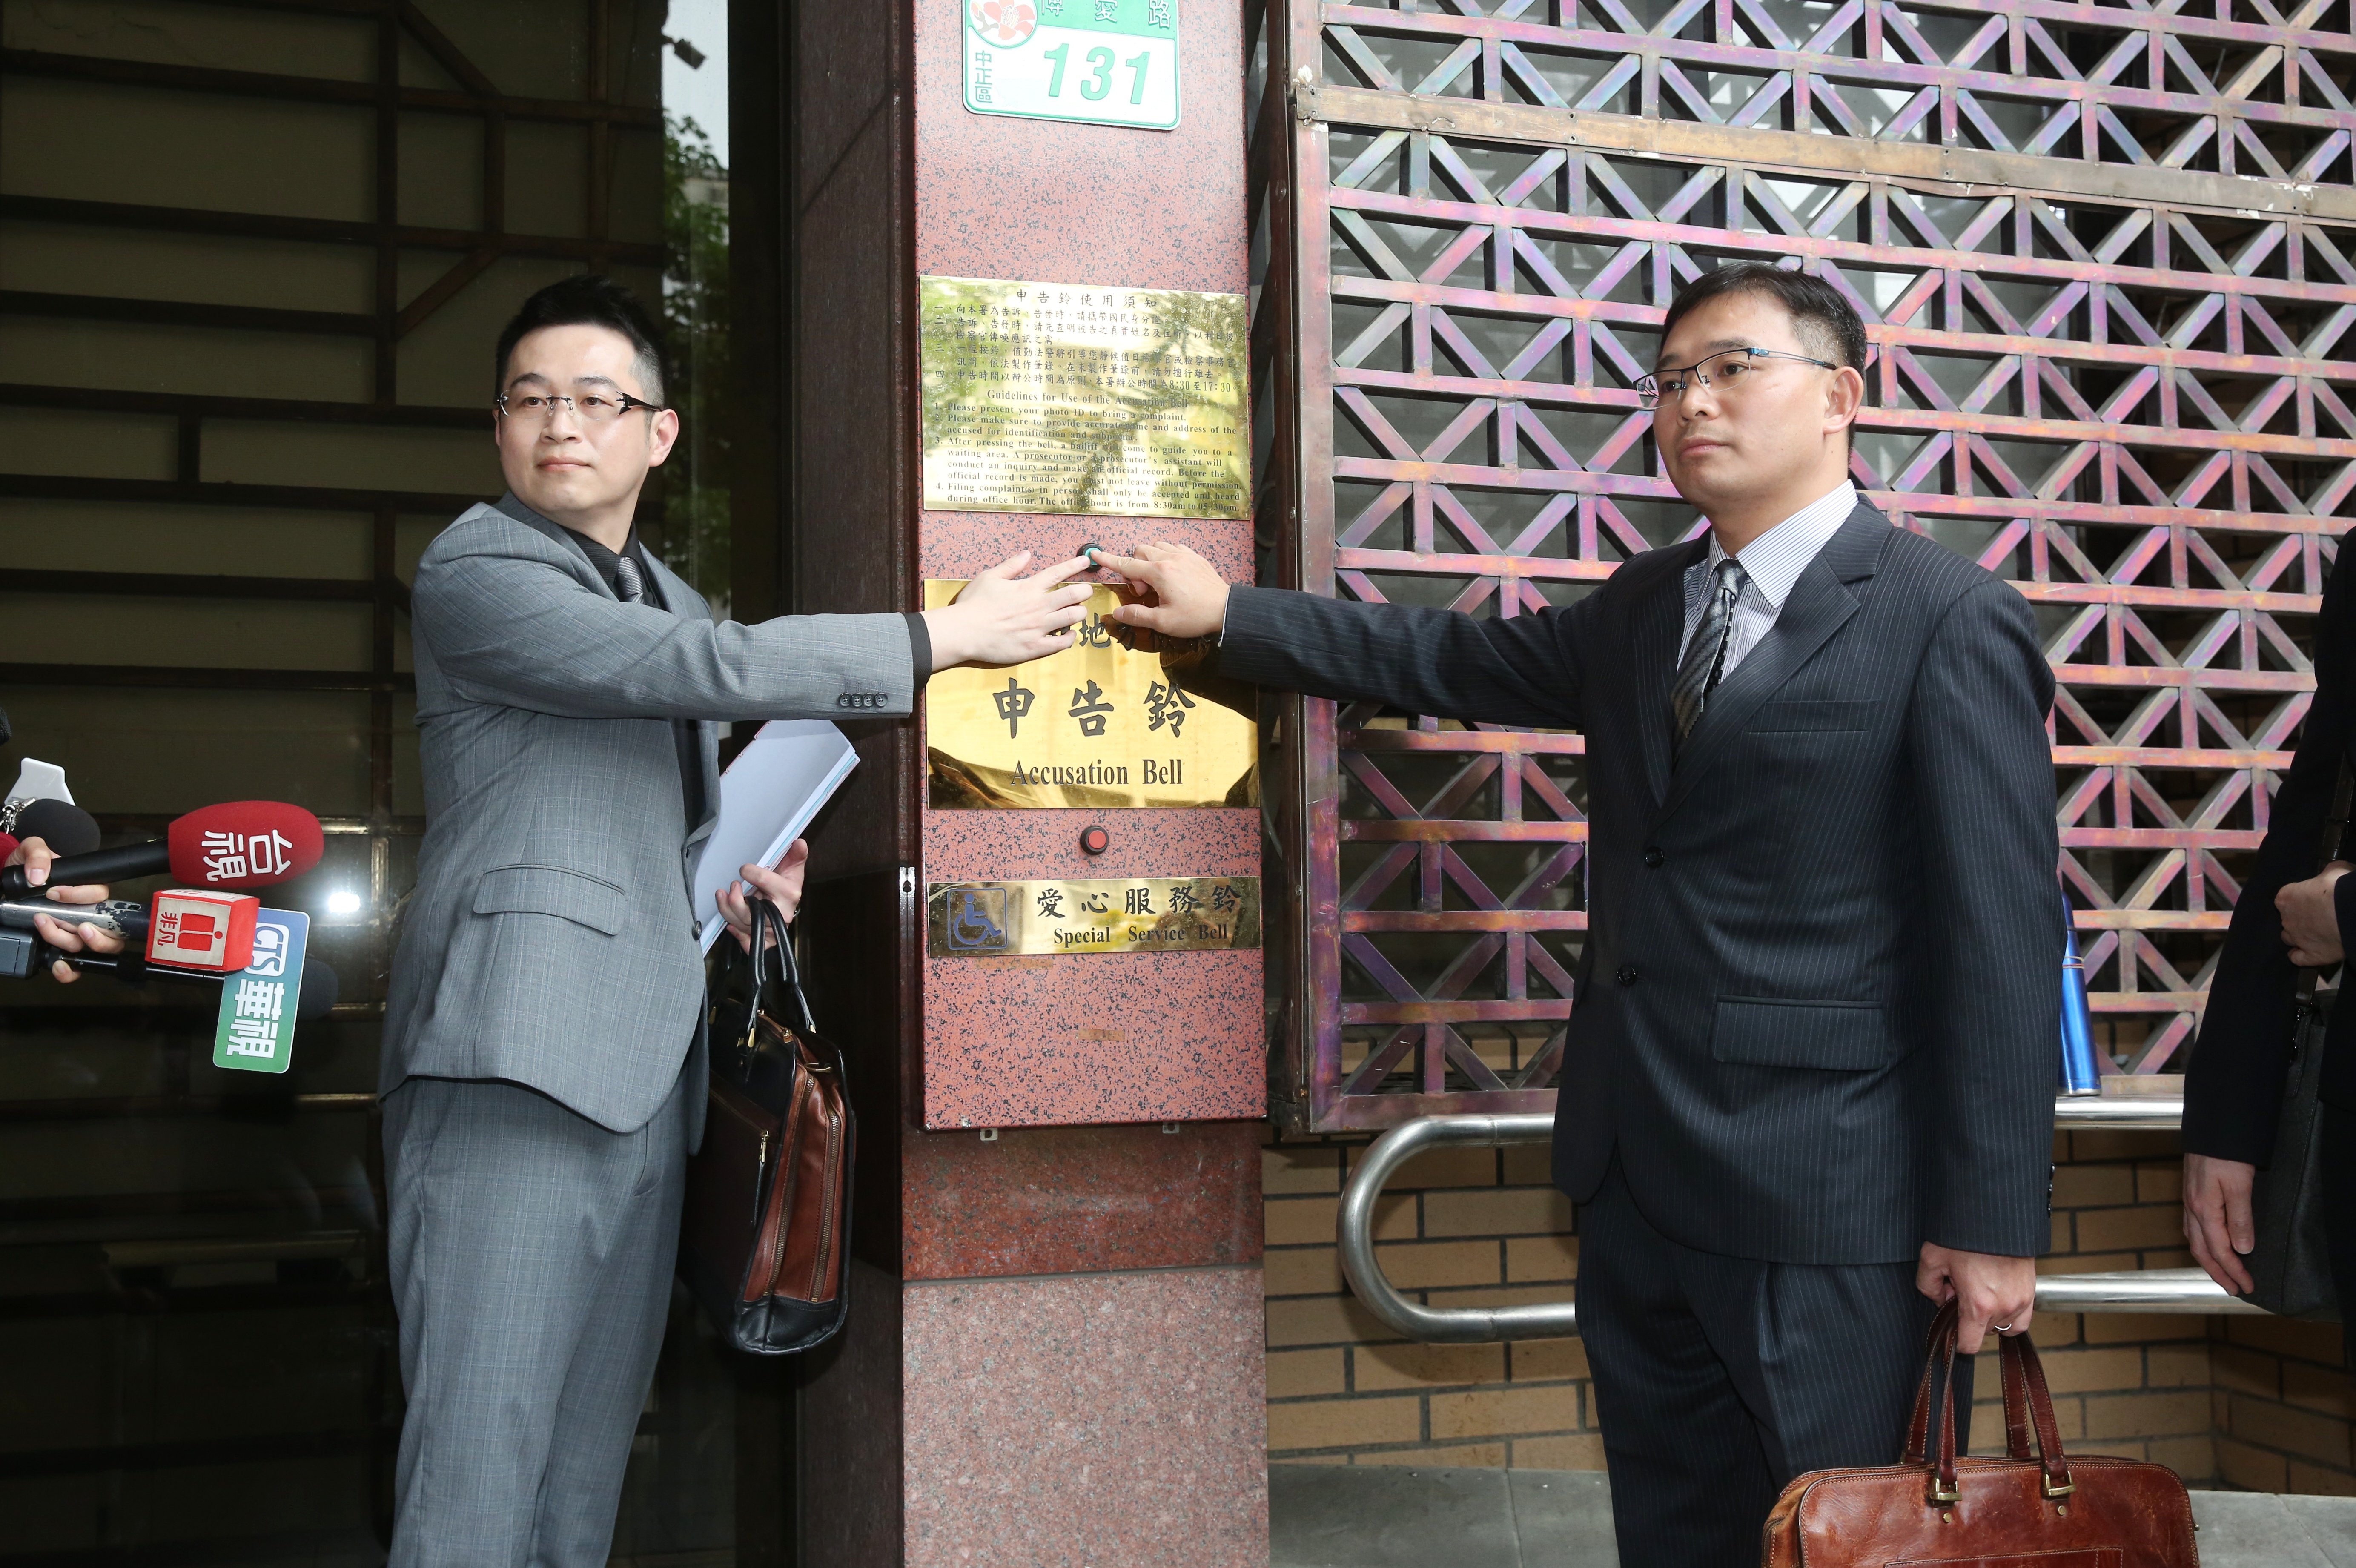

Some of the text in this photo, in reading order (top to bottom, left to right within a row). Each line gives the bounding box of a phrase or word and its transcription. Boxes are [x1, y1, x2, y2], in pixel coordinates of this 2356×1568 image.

[975, 50, 992, 103] 中正區
[1044, 43, 1150, 105] 131
[1016, 289, 1157, 309] 申告鈴使用須知
[987, 389, 1187, 408] Guidelines for Use of the Accusation Bell
[948, 403, 975, 412] Please
[980, 405, 1014, 413] present
[1018, 408, 1039, 416] your
[1044, 407, 1069, 416] photo
[1103, 410, 1126, 420] bring
[1140, 413, 1186, 421] complaint.
[948, 415, 976, 423] Please
[1046, 419, 1080, 428] provide
[1211, 426, 1220, 434] of
[1005, 429, 1066, 438] identification
[1071, 430, 1086, 439] and
[948, 437, 972, 445] After
[976, 439, 1014, 448] pressing
[1037, 441, 1056, 450] bell,
[1071, 441, 1098, 450] bailiff
[1162, 447, 1186, 456] guide
[948, 449, 981, 459] waiting
[1024, 453, 1072, 461] prosecutor
[1206, 459, 1222, 467] will
[948, 461, 983, 469] conduct
[1004, 462, 1037, 472] inquiry
[1064, 464, 1086, 473] make
[1107, 466, 1138, 474] official
[1143, 467, 1174, 476] record.
[1178, 469, 1206, 477] Before
[948, 472, 980, 480] official
[985, 473, 1014, 481] record
[1031, 474, 1058, 484] made,
[1155, 479, 1187, 487] without
[1192, 482, 1242, 490] permission.
[948, 483, 974, 493] Filing
[980, 485, 1035, 494] complaint(s)
[1053, 487, 1083, 497] person
[1114, 490, 1132, 498] only
[1152, 491, 1189, 499] accepted
[1215, 492, 1239, 500] heard
[948, 494, 978, 504] during
[1014, 496, 1036, 505] hour.
[1040, 497, 1056, 505] The
[1090, 499, 1111, 507] hour
[1154, 501, 1185, 509] 8:30am
[992, 677, 1196, 739] 申告鈴
[1010, 759, 1182, 785] Accusation Bell
[202, 829, 292, 882] 台視
[1037, 885, 1242, 919] 愛心服務鈴
[157, 912, 178, 946] 非凡
[1054, 924, 1227, 948] Special Service Bell
[226, 978, 285, 1058] 華視
